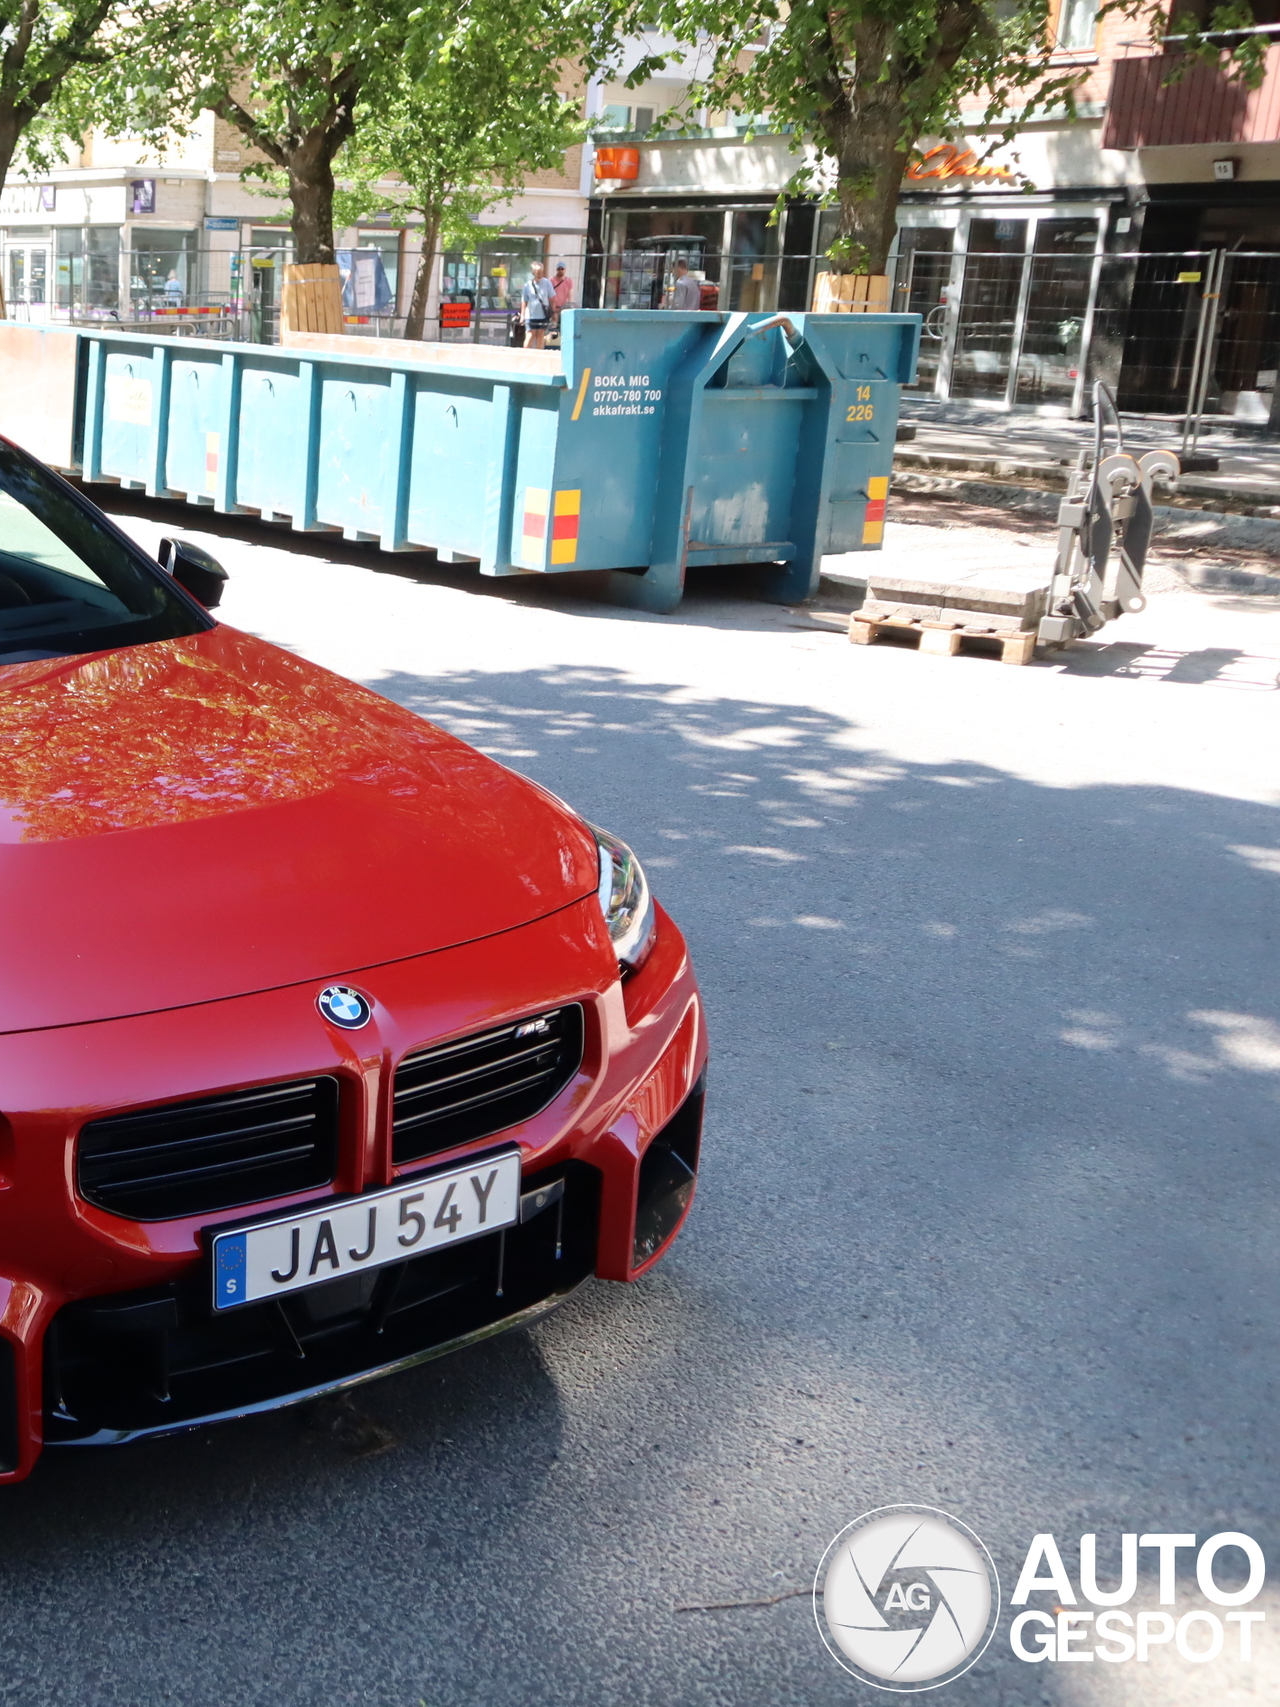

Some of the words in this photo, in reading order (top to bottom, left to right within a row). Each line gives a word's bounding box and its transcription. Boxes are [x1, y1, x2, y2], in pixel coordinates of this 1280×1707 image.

[1217, 164, 1229, 174] 15
[594, 375, 626, 387] BOKA
[629, 375, 650, 387] MIG
[593, 390, 642, 402] 0770-780
[644, 389, 662, 401] 700
[856, 385, 871, 401] 14
[593, 404, 655, 416] akkafrakt.se
[846, 404, 874, 422] 226
[319, 986, 359, 1004] BMW
[271, 1206, 377, 1284] JAJ
[397, 1168, 500, 1248] 54Y
[225, 1278, 237, 1294] S
